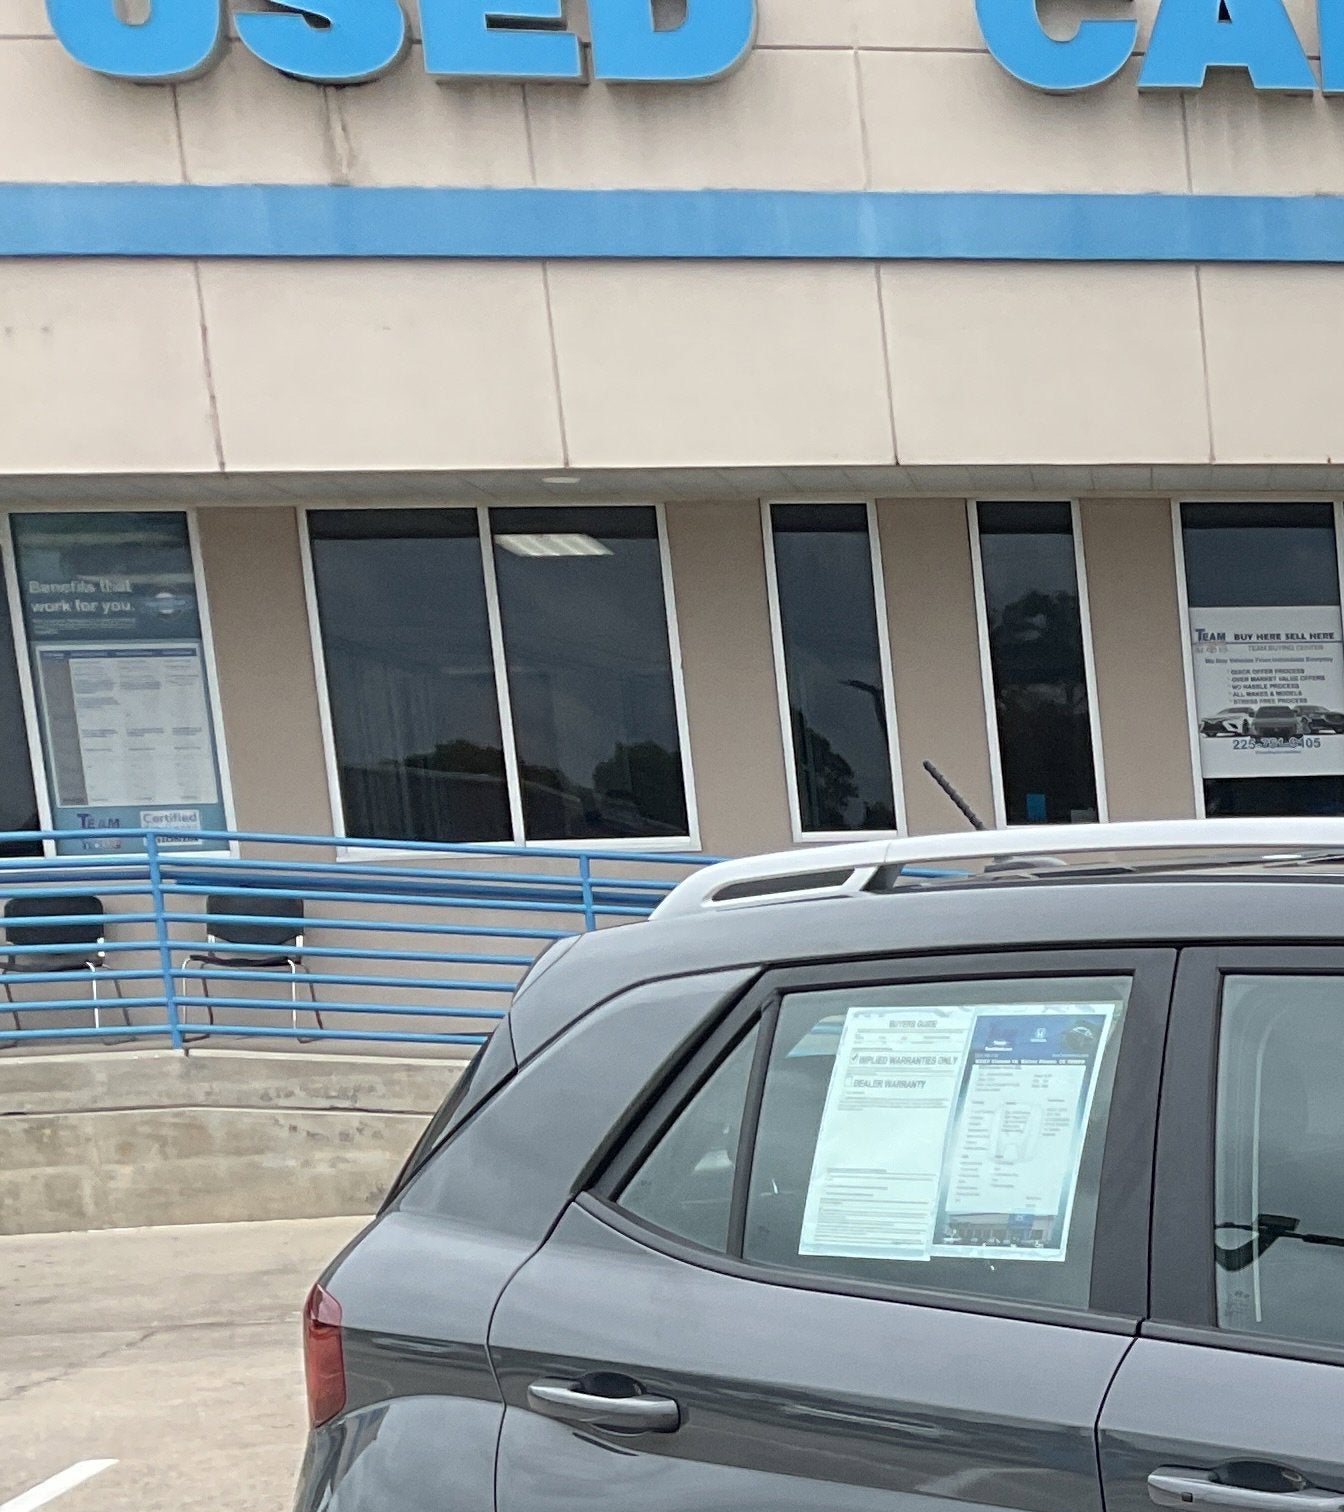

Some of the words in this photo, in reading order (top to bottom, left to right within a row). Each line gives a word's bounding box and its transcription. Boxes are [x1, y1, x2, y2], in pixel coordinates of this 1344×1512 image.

[29, 581, 97, 594] Benefits
[100, 579, 132, 593] that
[31, 600, 71, 612] work
[75, 599, 98, 612] for
[101, 601, 136, 615] you.
[1195, 628, 1226, 642] TEAM
[1234, 632, 1253, 641] BUY
[1256, 632, 1281, 641] HERE
[1285, 631, 1307, 640] SELL
[1309, 631, 1335, 640] HERE
[143, 812, 197, 824] Certified
[859, 1056, 888, 1065] IMPLIED
[889, 1056, 937, 1065] WARRANTIES
[938, 1056, 958, 1064] ONLY
[853, 1080, 882, 1088] DEALER
[884, 1080, 926, 1088] WARRANTY
